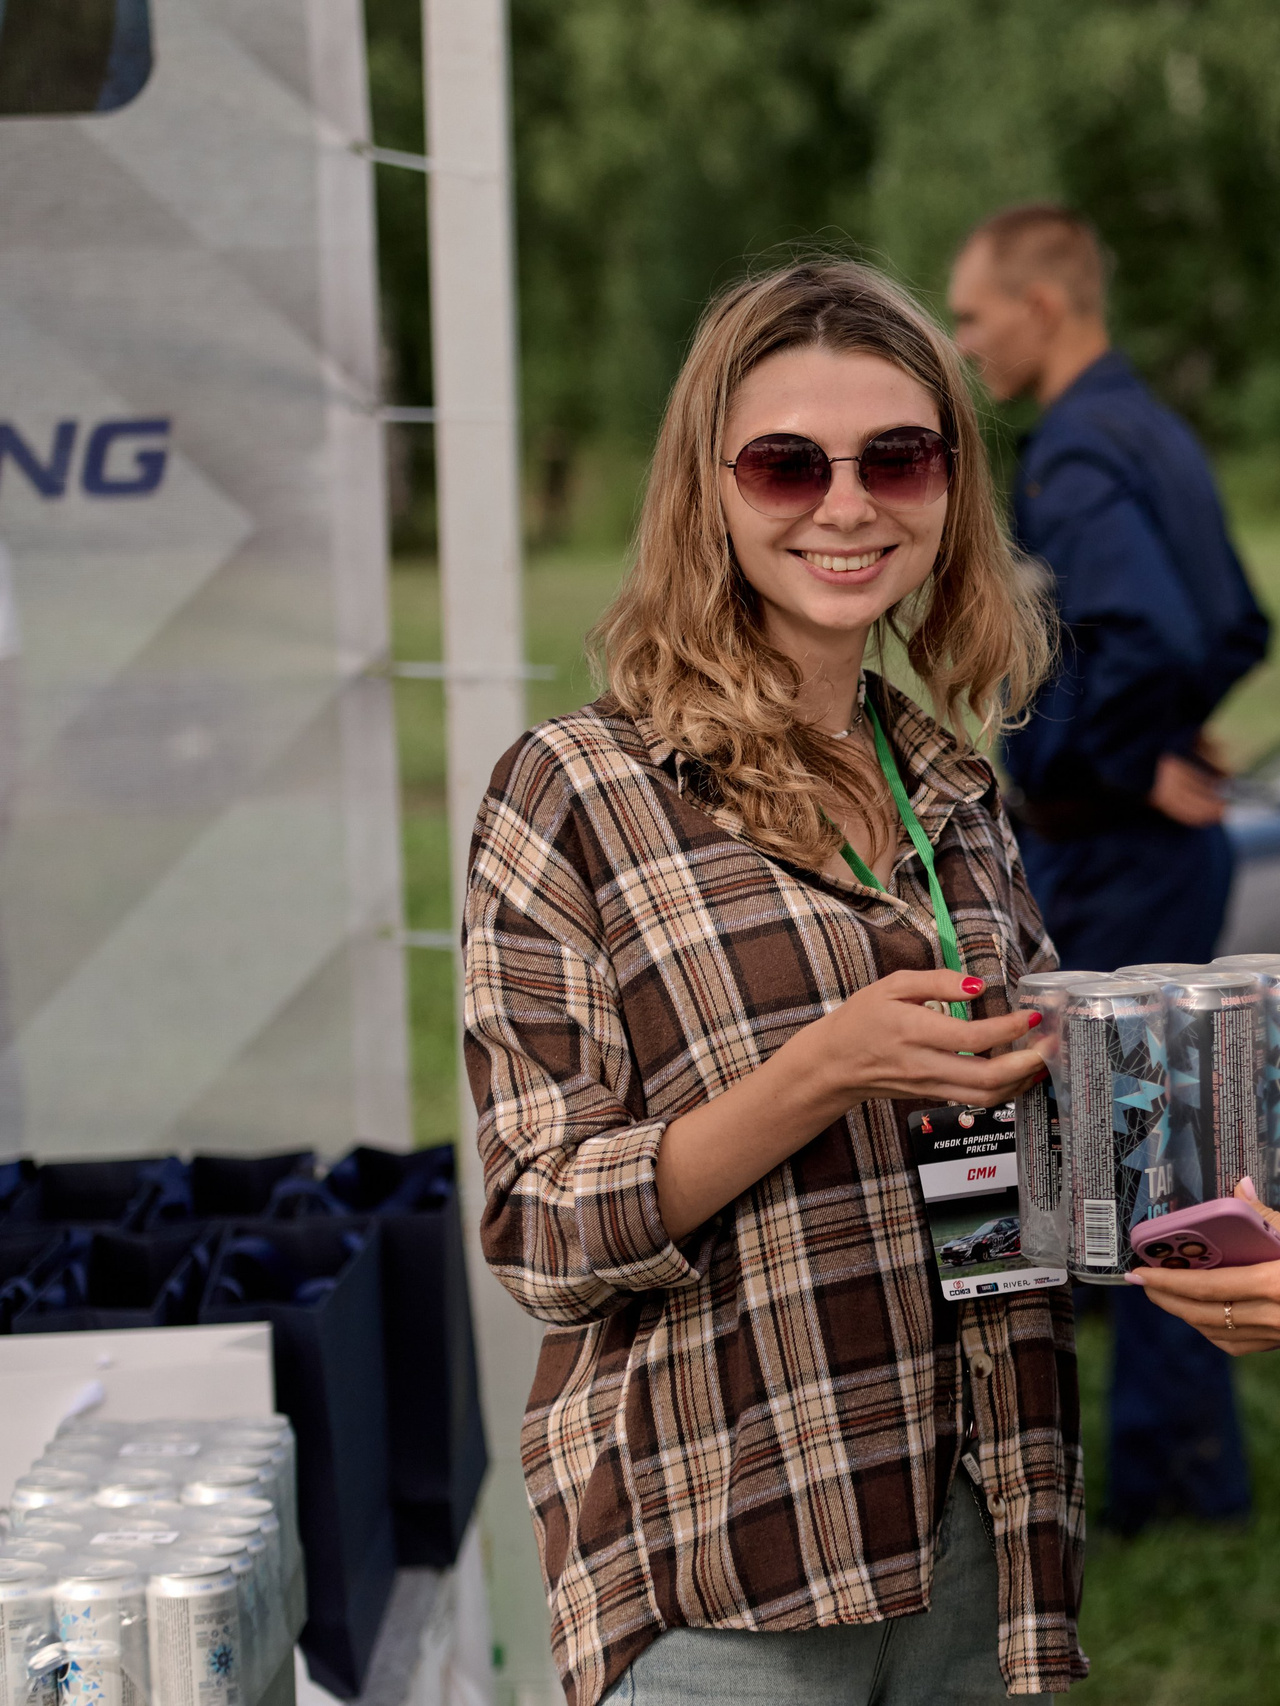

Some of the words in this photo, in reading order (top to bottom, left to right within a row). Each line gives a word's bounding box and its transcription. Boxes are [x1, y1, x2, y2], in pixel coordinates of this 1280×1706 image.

[994, 1110, 1016, 1119] РАК
[934, 1138, 961, 1149] КУБОК
[966, 1142, 998, 1154] РАКЕТЫ
[967, 1165, 997, 1181] СМИ
[1003, 1279, 1031, 1289] RIVER
